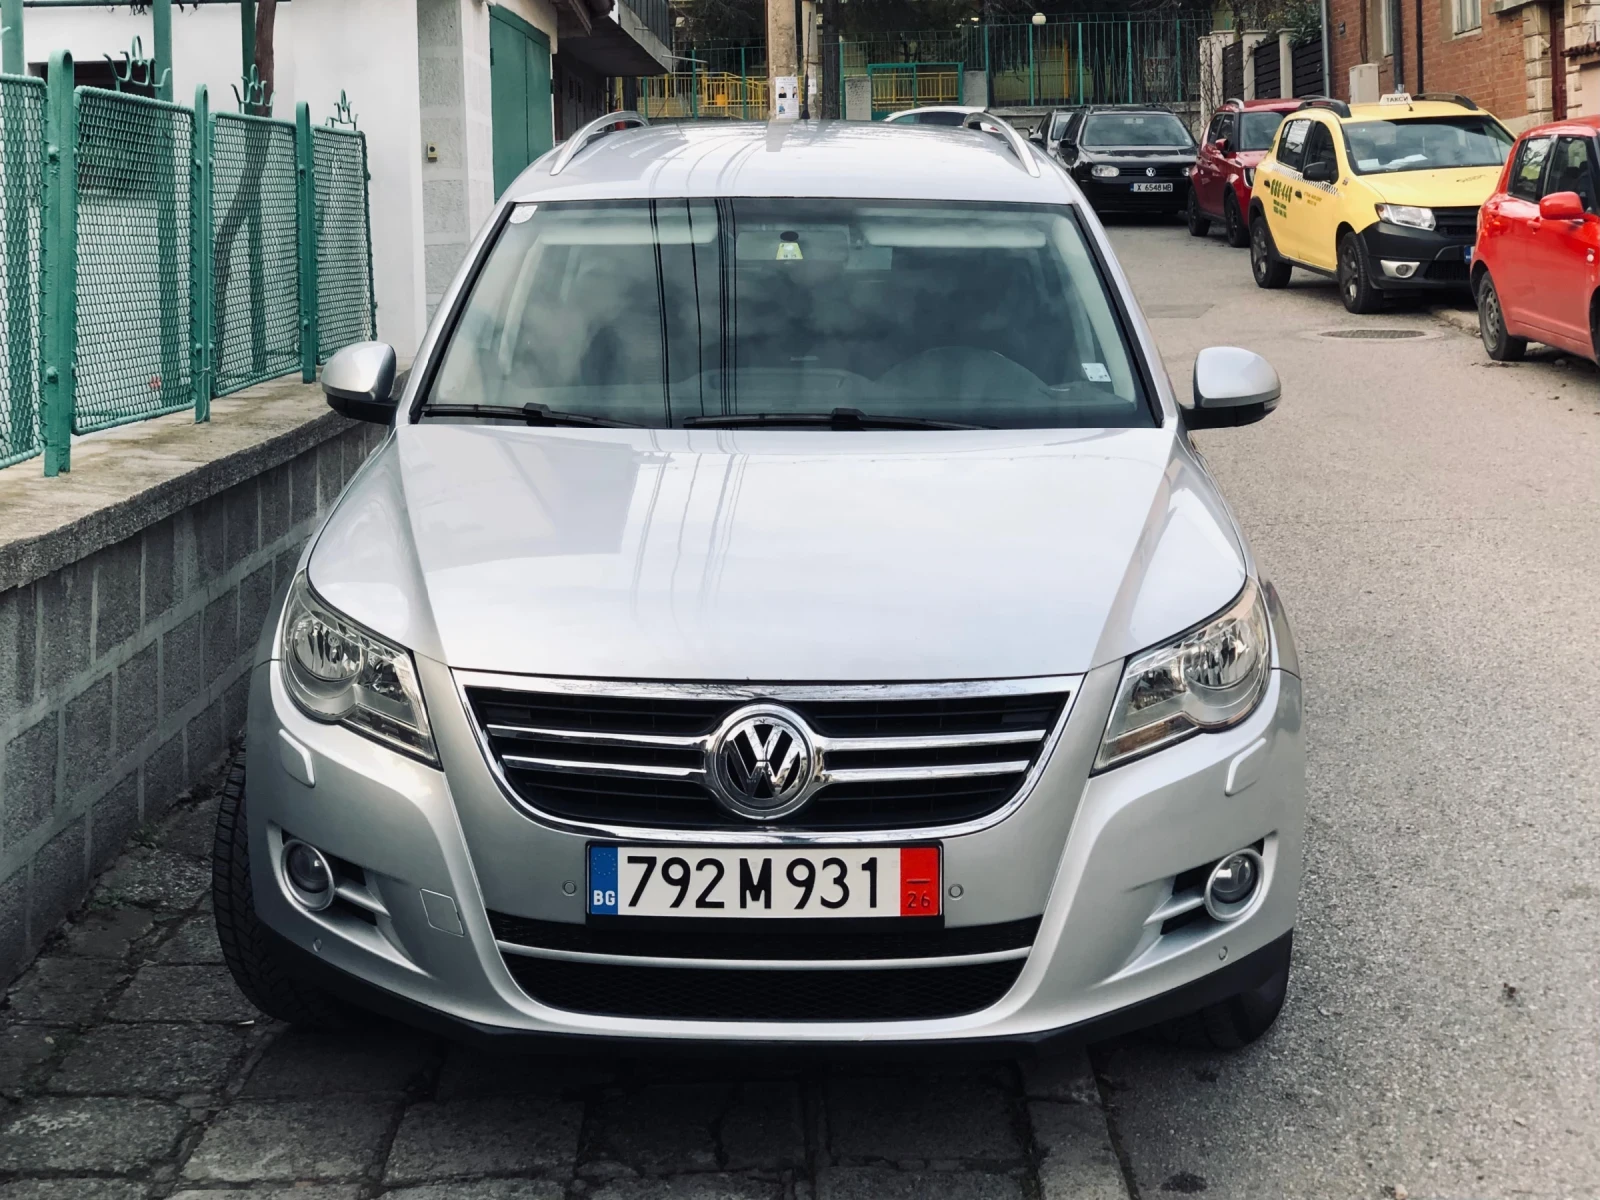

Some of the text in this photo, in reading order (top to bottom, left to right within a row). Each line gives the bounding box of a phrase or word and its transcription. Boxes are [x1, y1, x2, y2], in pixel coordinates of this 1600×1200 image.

[627, 855, 878, 910] 792 M 931
[593, 889, 616, 906] BG
[907, 890, 931, 909] 26
